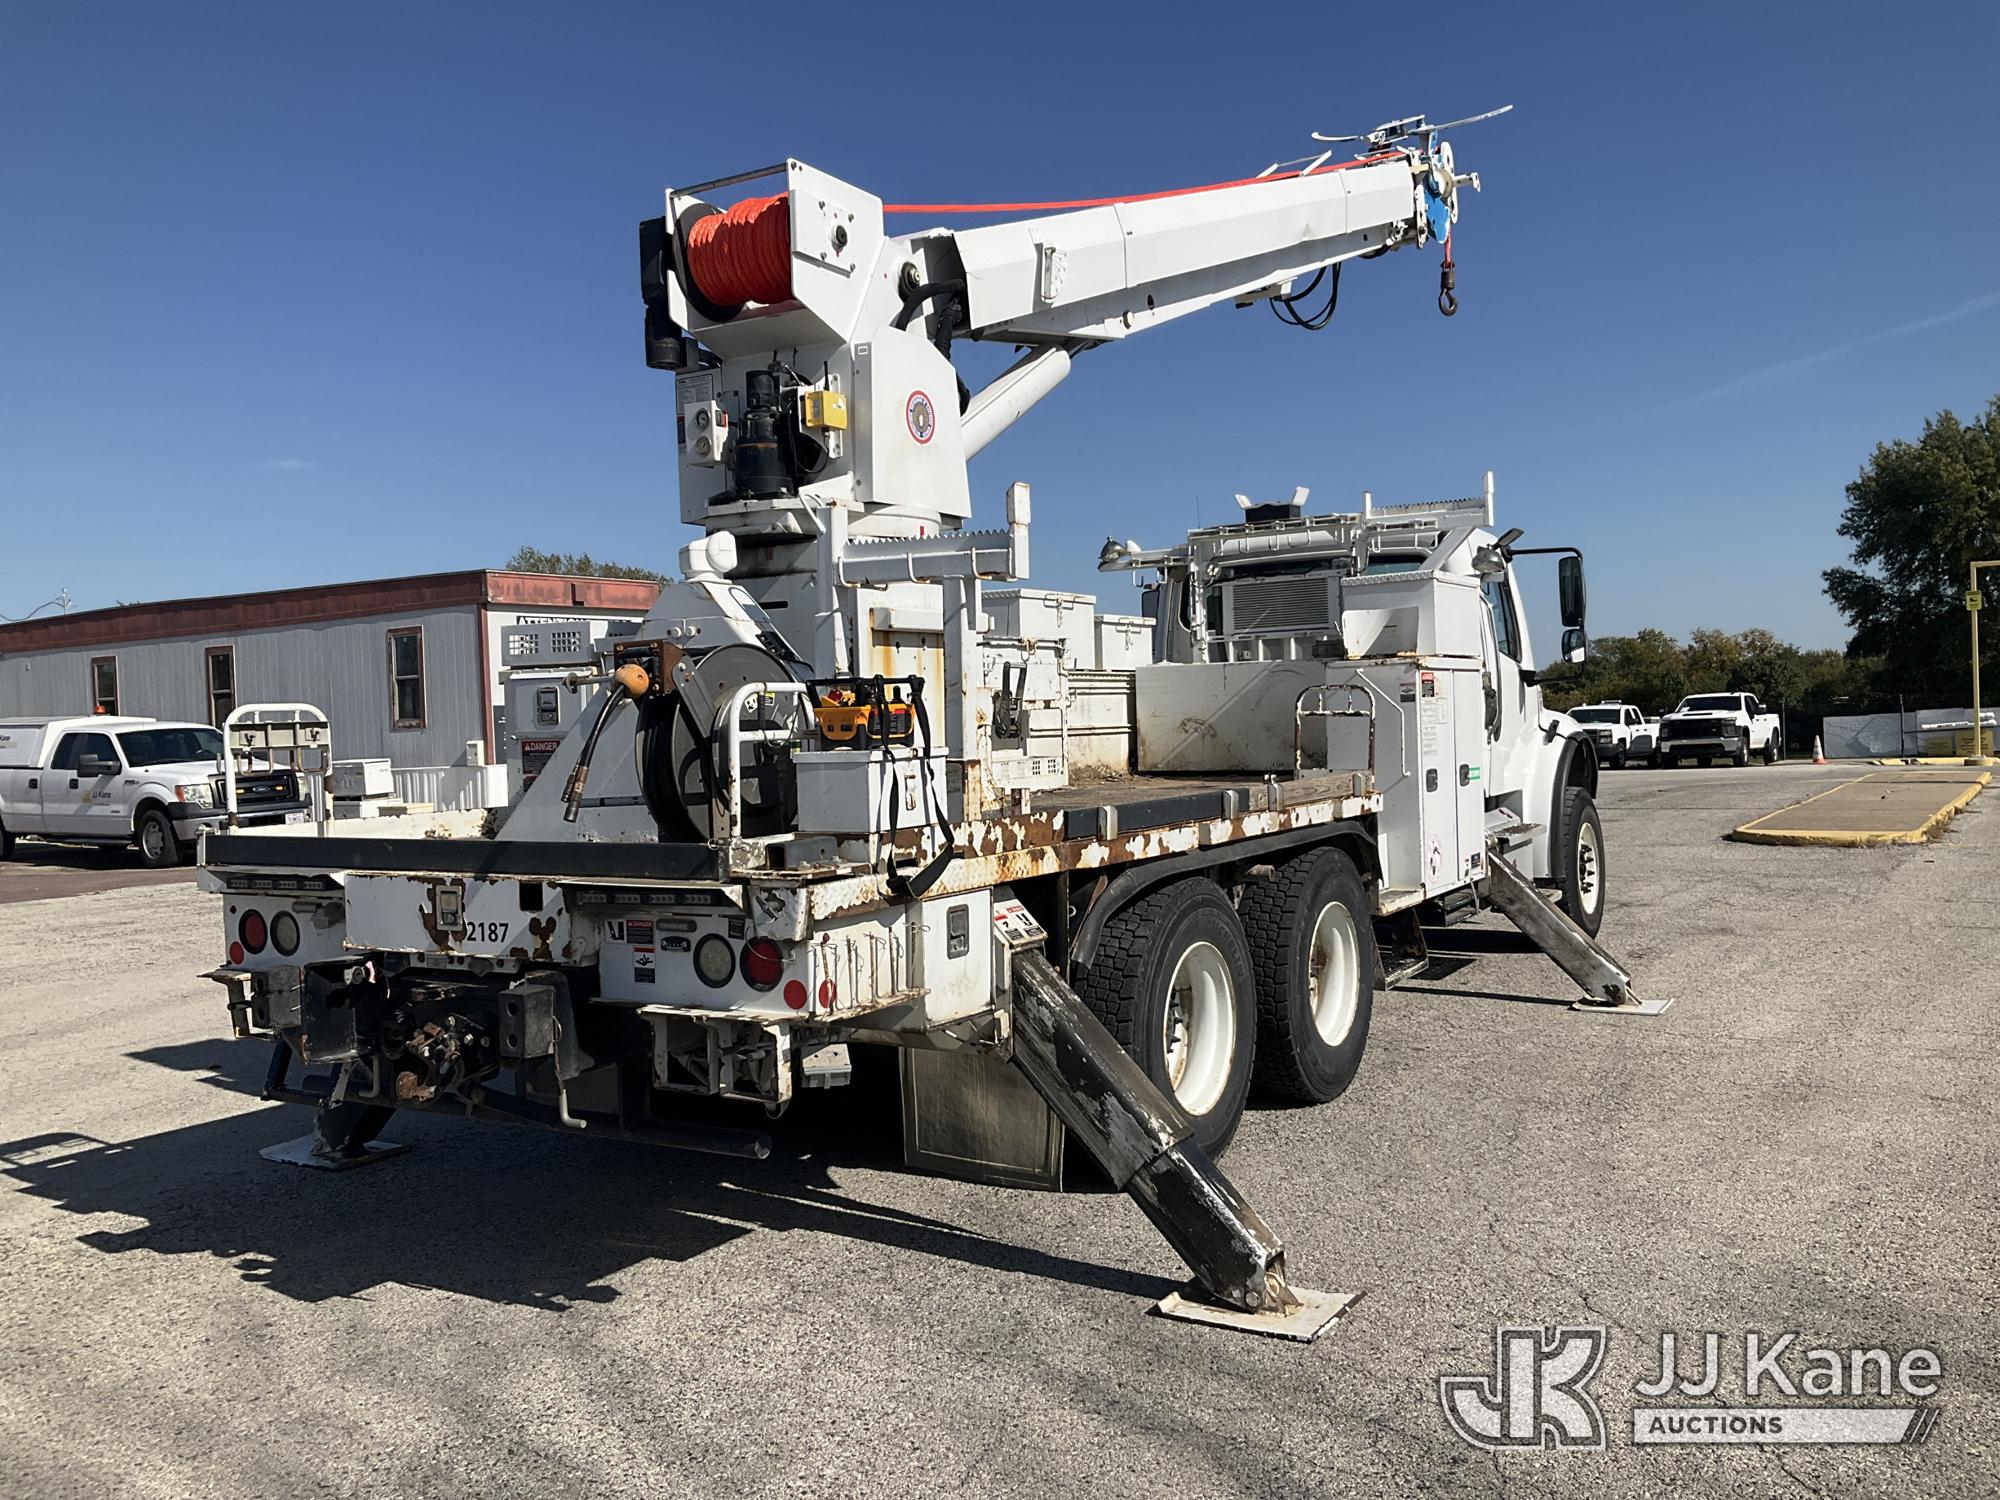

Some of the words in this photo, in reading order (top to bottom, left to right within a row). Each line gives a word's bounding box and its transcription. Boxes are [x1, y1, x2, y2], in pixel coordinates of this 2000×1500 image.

[518, 616, 586, 626] ATTENT
[530, 742, 558, 751] DANGER
[466, 921, 509, 943] 2187
